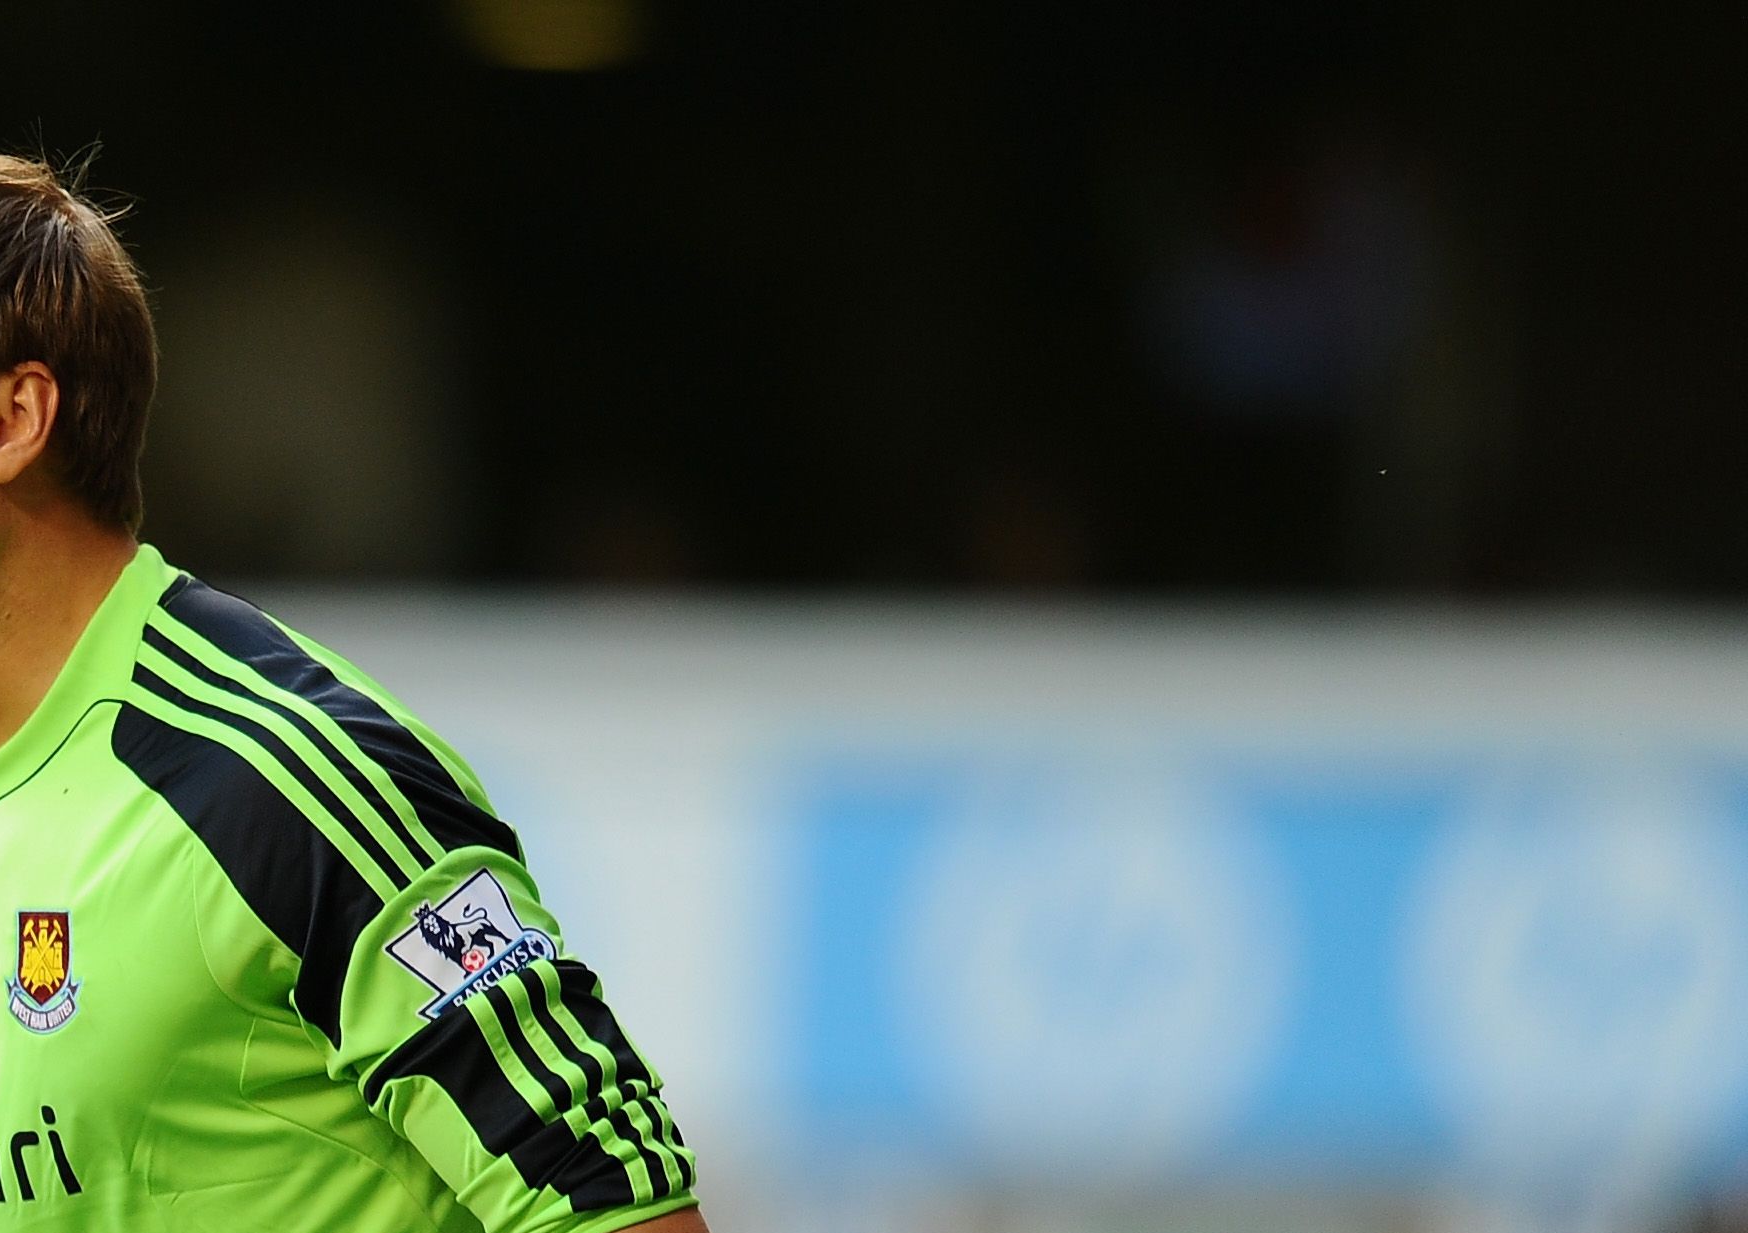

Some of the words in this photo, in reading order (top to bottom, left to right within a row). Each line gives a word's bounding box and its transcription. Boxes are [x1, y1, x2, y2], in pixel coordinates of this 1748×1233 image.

[452, 945, 530, 1008] BARCLAYS
[12, 996, 31, 1026] WEST
[47, 999, 73, 1028] UNITED
